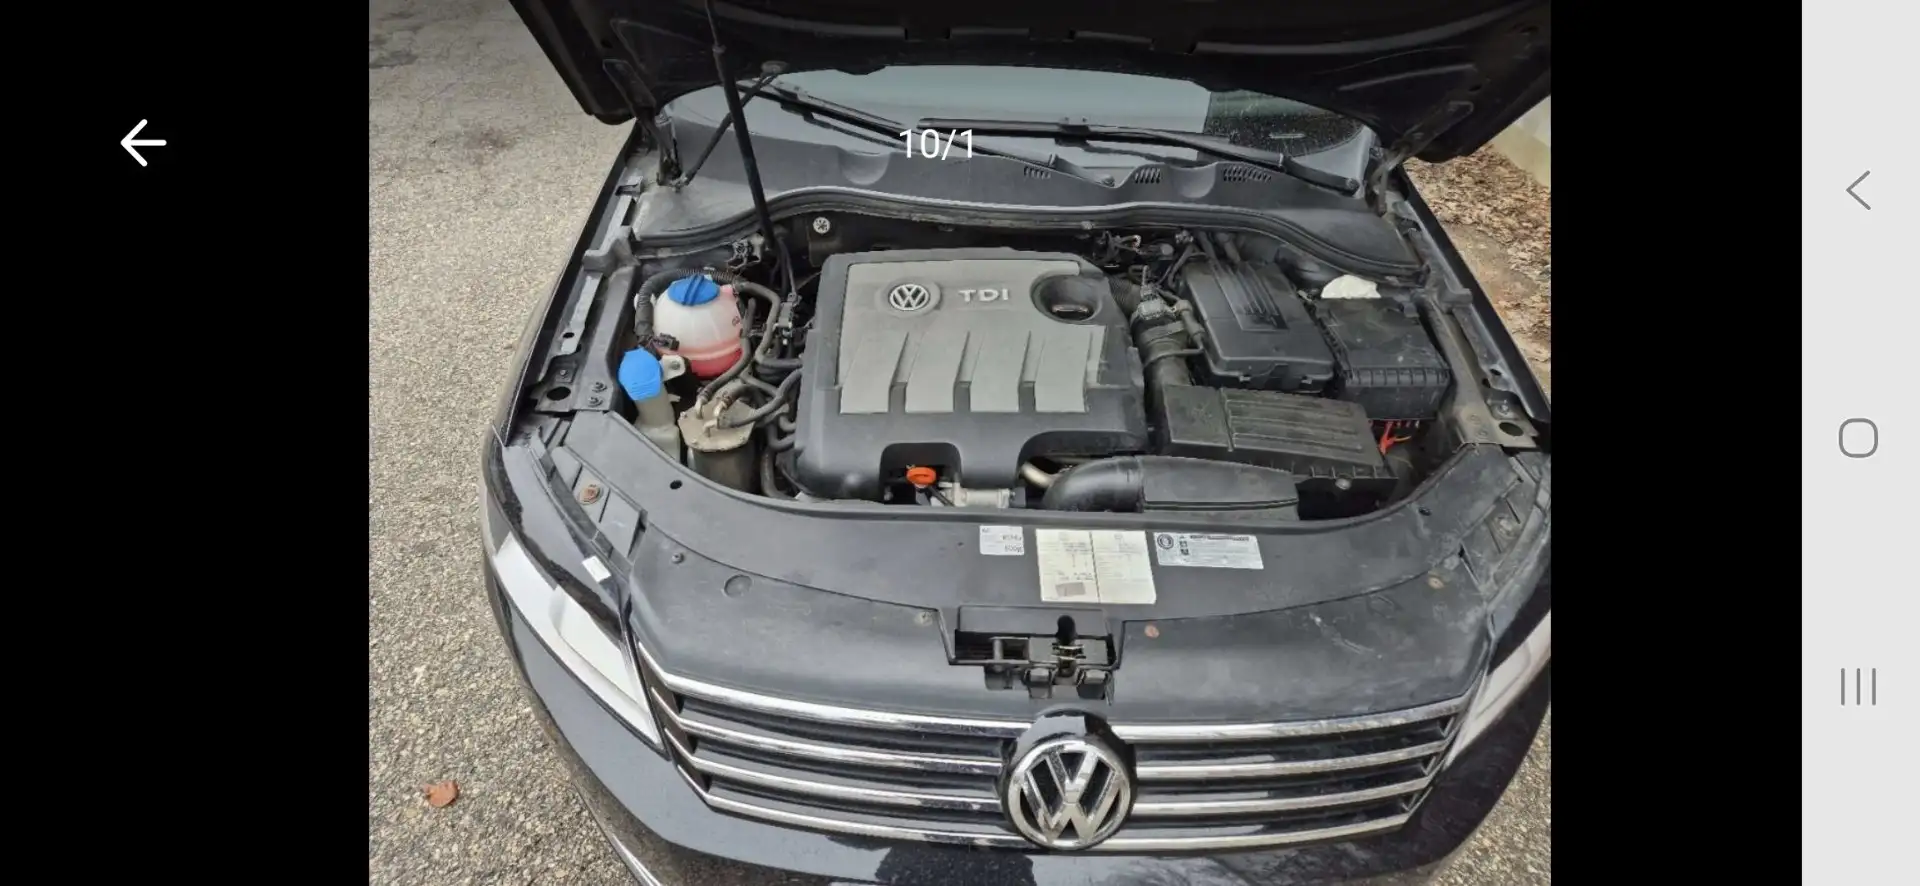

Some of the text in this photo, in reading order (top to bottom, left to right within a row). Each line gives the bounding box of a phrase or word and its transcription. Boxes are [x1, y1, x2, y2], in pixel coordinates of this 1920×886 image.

[889, 283, 930, 311] VW
[959, 288, 1009, 302] TDI
[1008, 740, 1131, 850] VW
